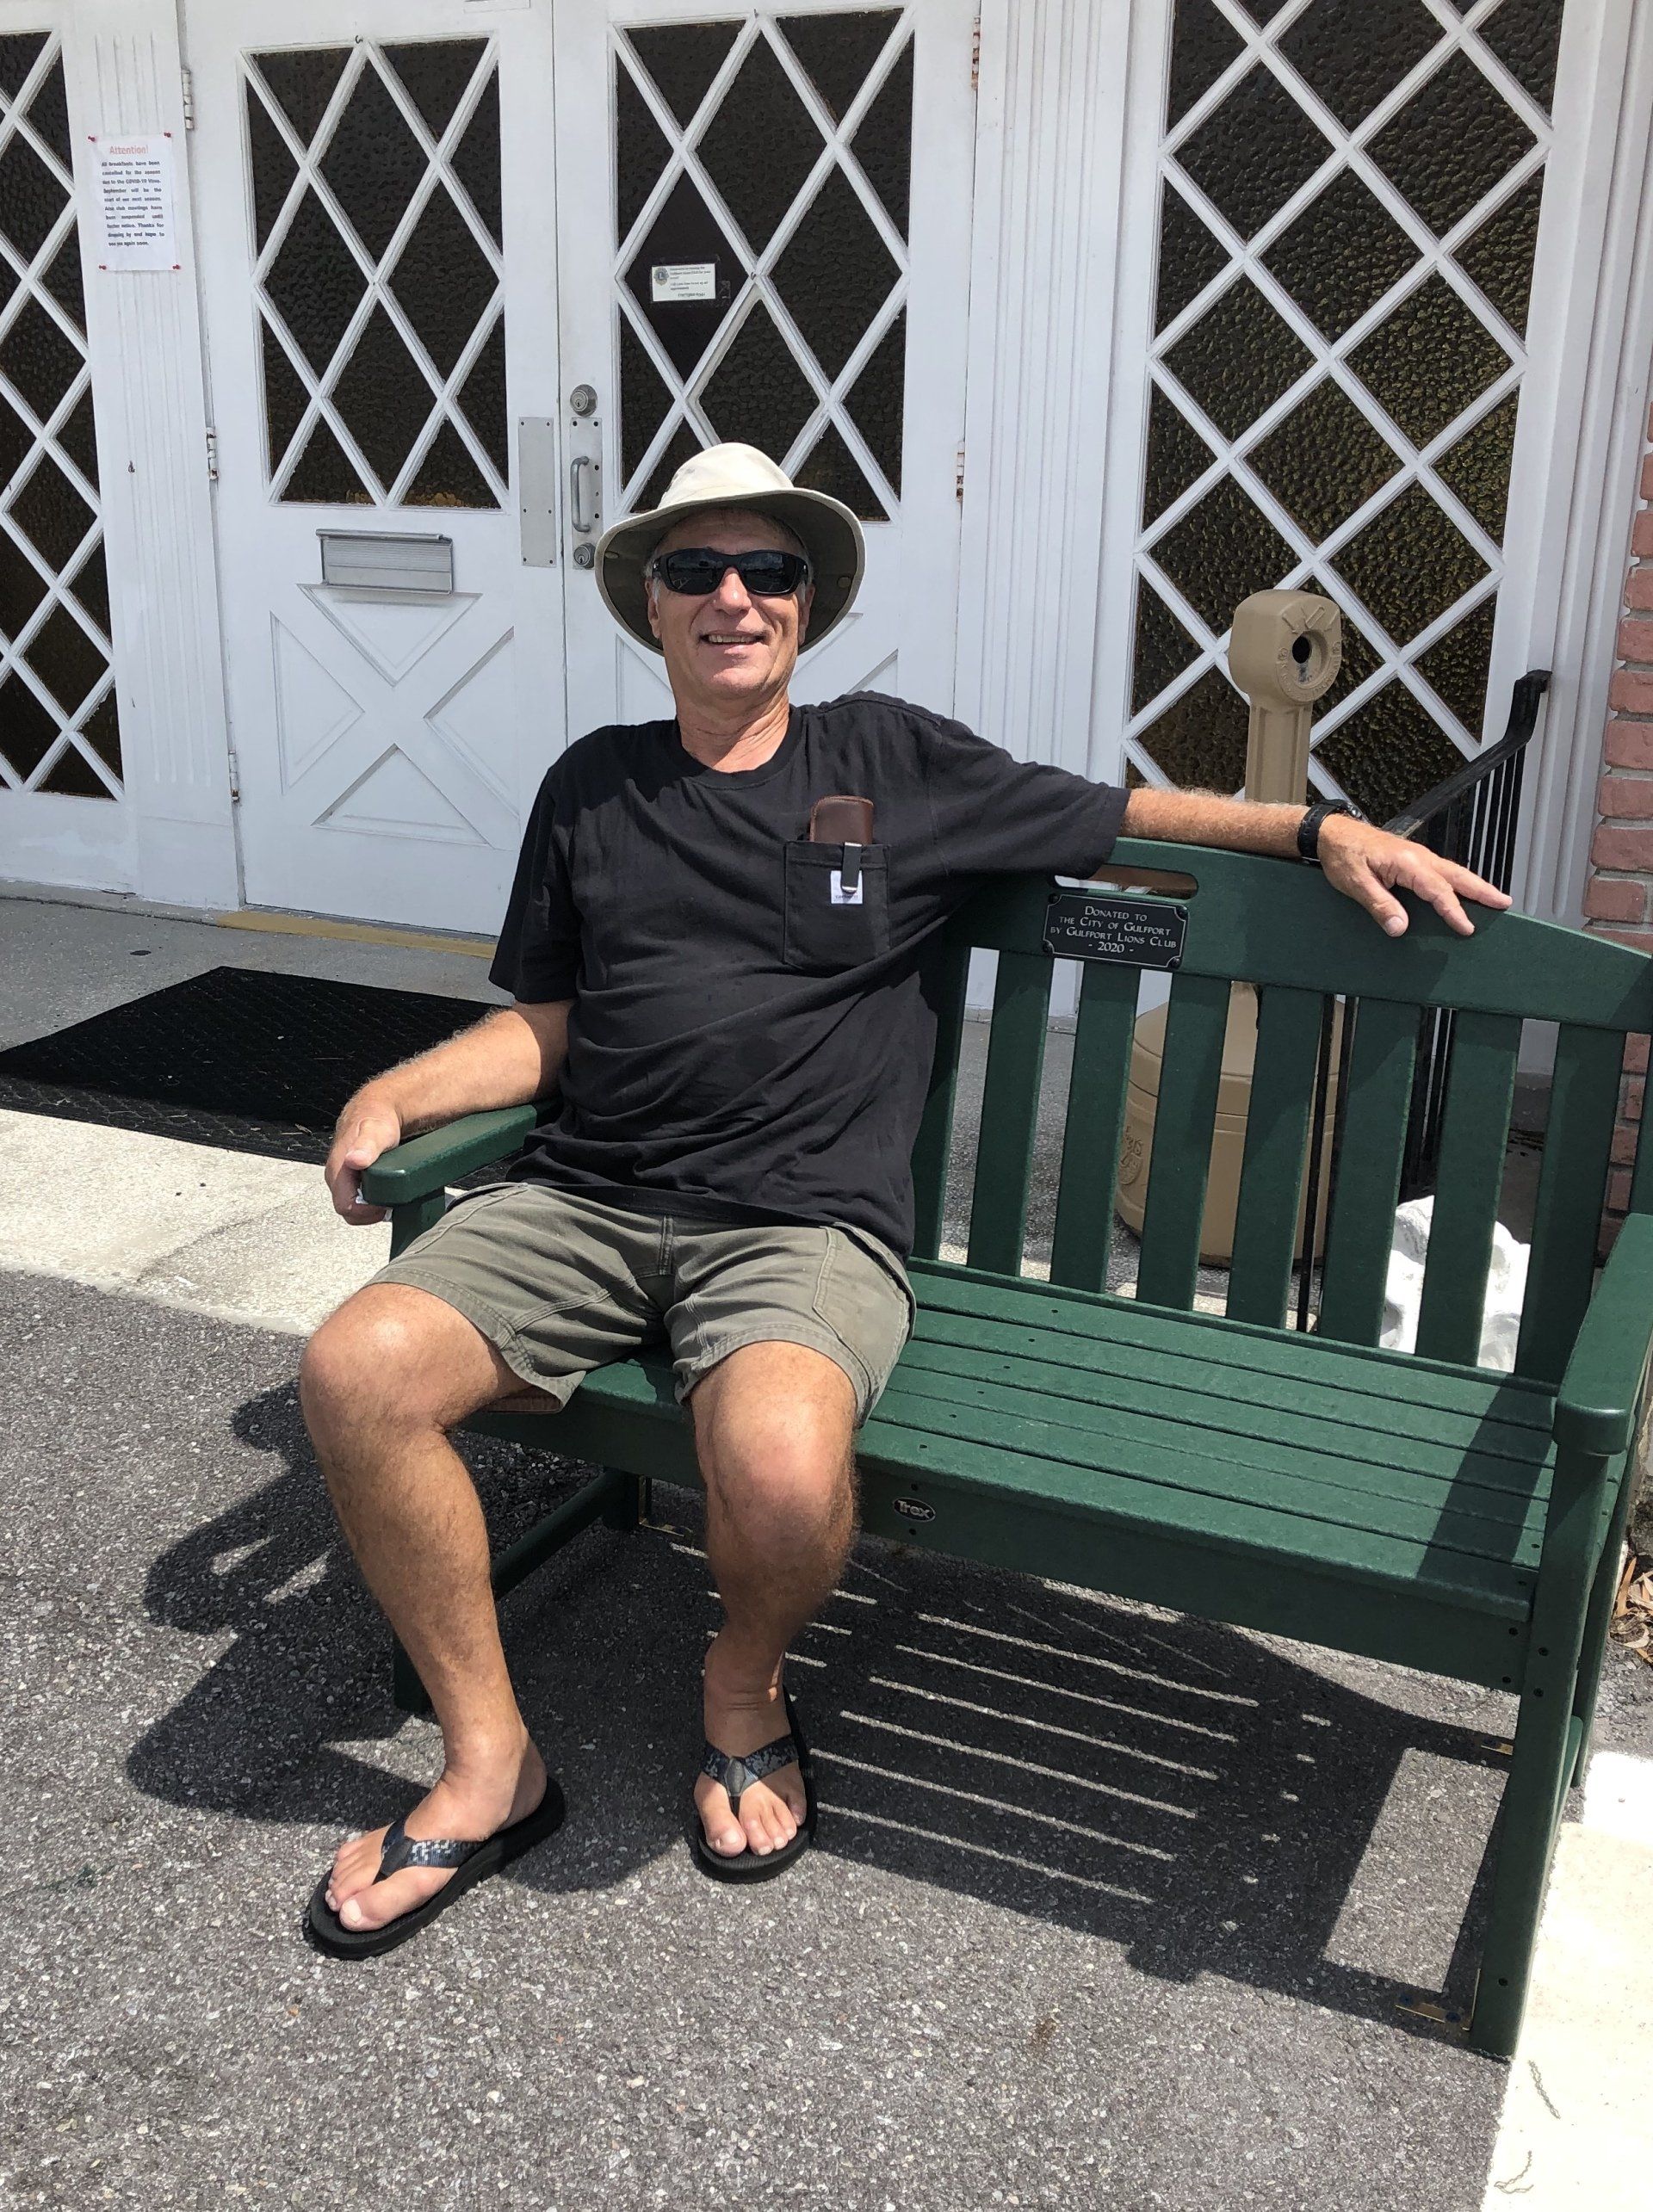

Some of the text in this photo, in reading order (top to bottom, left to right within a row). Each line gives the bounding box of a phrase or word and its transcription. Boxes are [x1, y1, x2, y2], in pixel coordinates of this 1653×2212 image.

[109, 145, 148, 154] Attention!
[1085, 905, 1129, 919] DONATED
[1059, 916, 1074, 924] THE
[1080, 917, 1104, 928] CITY
[1124, 923, 1171, 936] GULFPORT
[1067, 927, 1112, 940] GULFPORT
[1117, 933, 1145, 944] LIONS
[1150, 936, 1176, 948] CLUB
[1098, 942, 1124, 953] 2020
